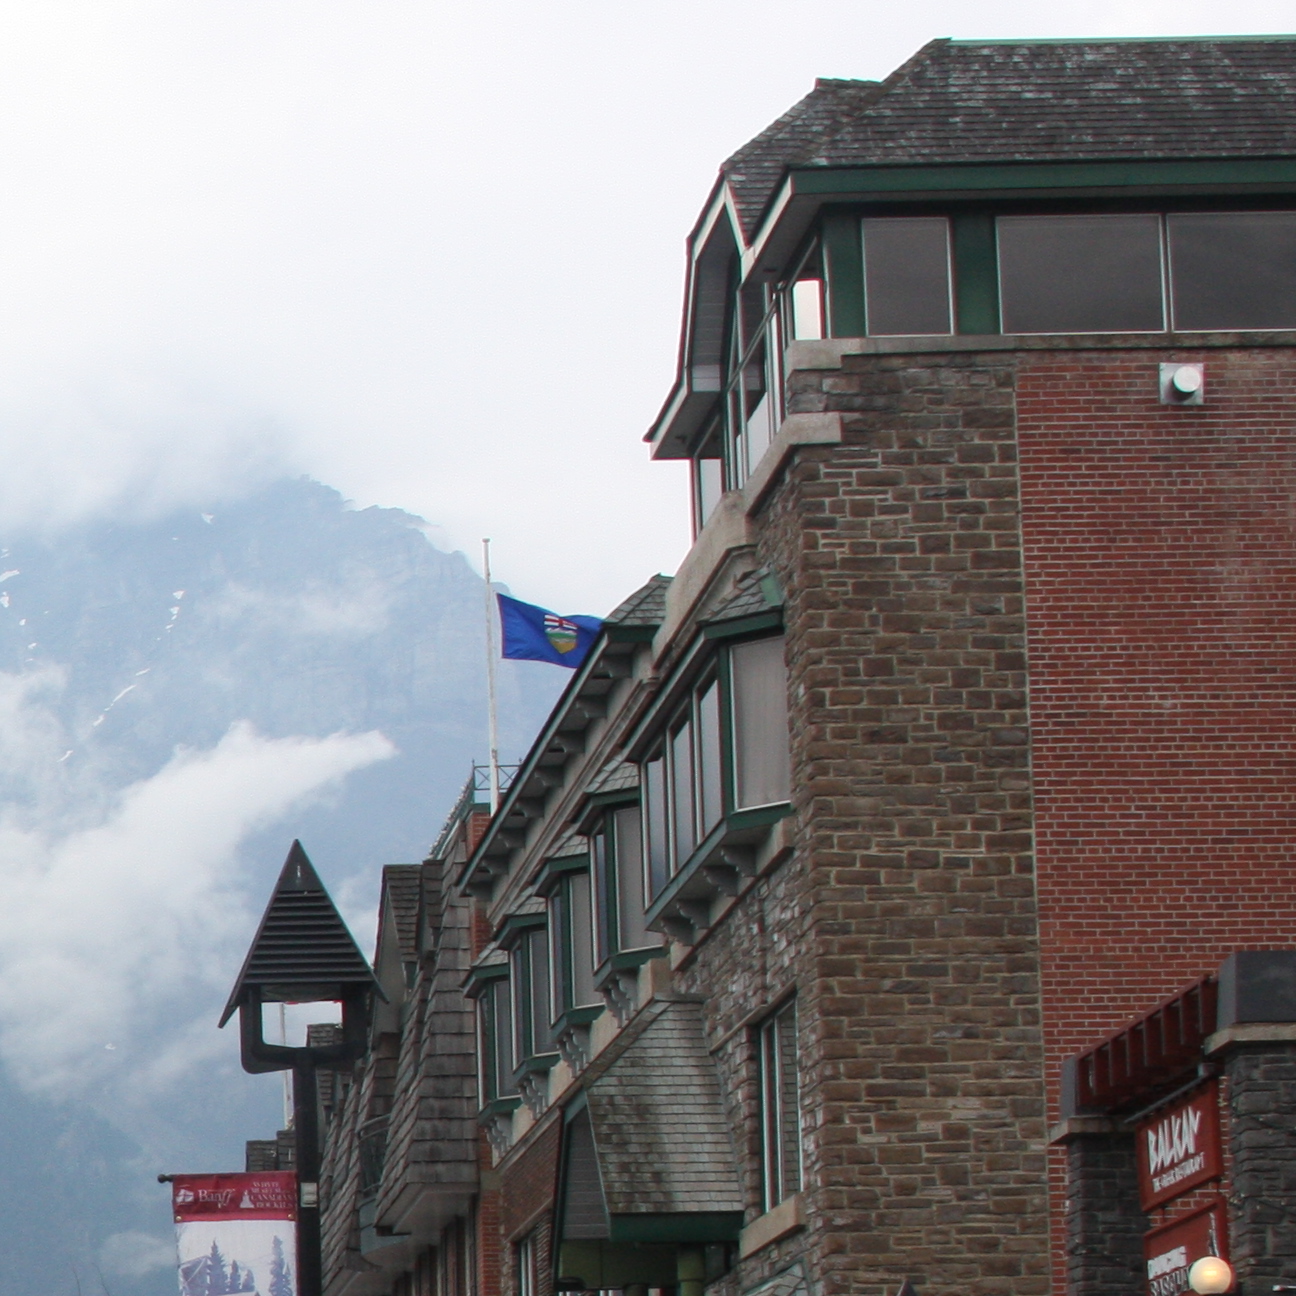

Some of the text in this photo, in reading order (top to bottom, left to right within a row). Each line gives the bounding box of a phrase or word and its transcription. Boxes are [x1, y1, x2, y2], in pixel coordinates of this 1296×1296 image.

[1147, 1105, 1202, 1175] BALKAN
[198, 1188, 236, 1209] Banff
[1147, 1245, 1188, 1281] DANCING
